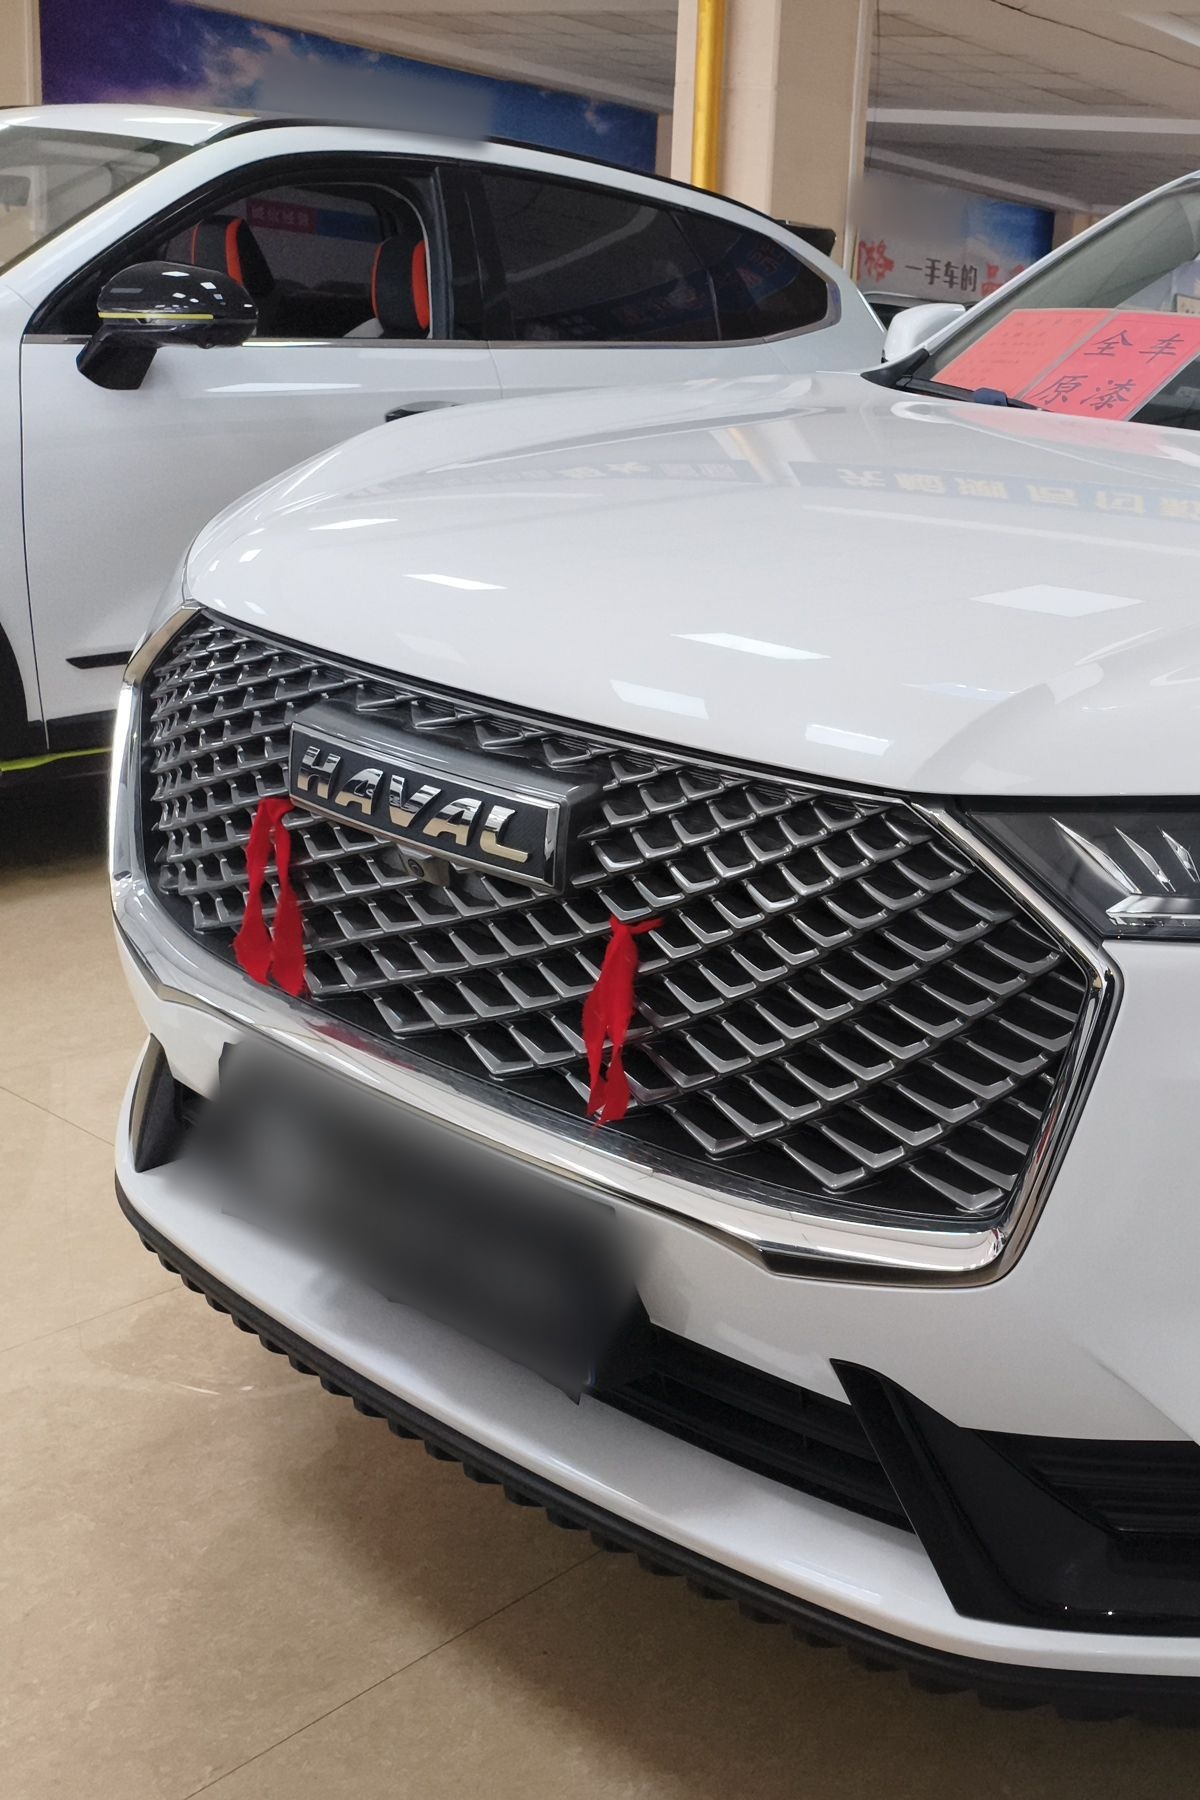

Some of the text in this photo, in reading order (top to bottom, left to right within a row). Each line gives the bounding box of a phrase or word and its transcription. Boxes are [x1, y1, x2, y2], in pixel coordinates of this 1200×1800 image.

[1083, 329, 1185, 363] 全车
[1030, 375, 1137, 410] 原漆
[297, 745, 529, 864] HAVAL
